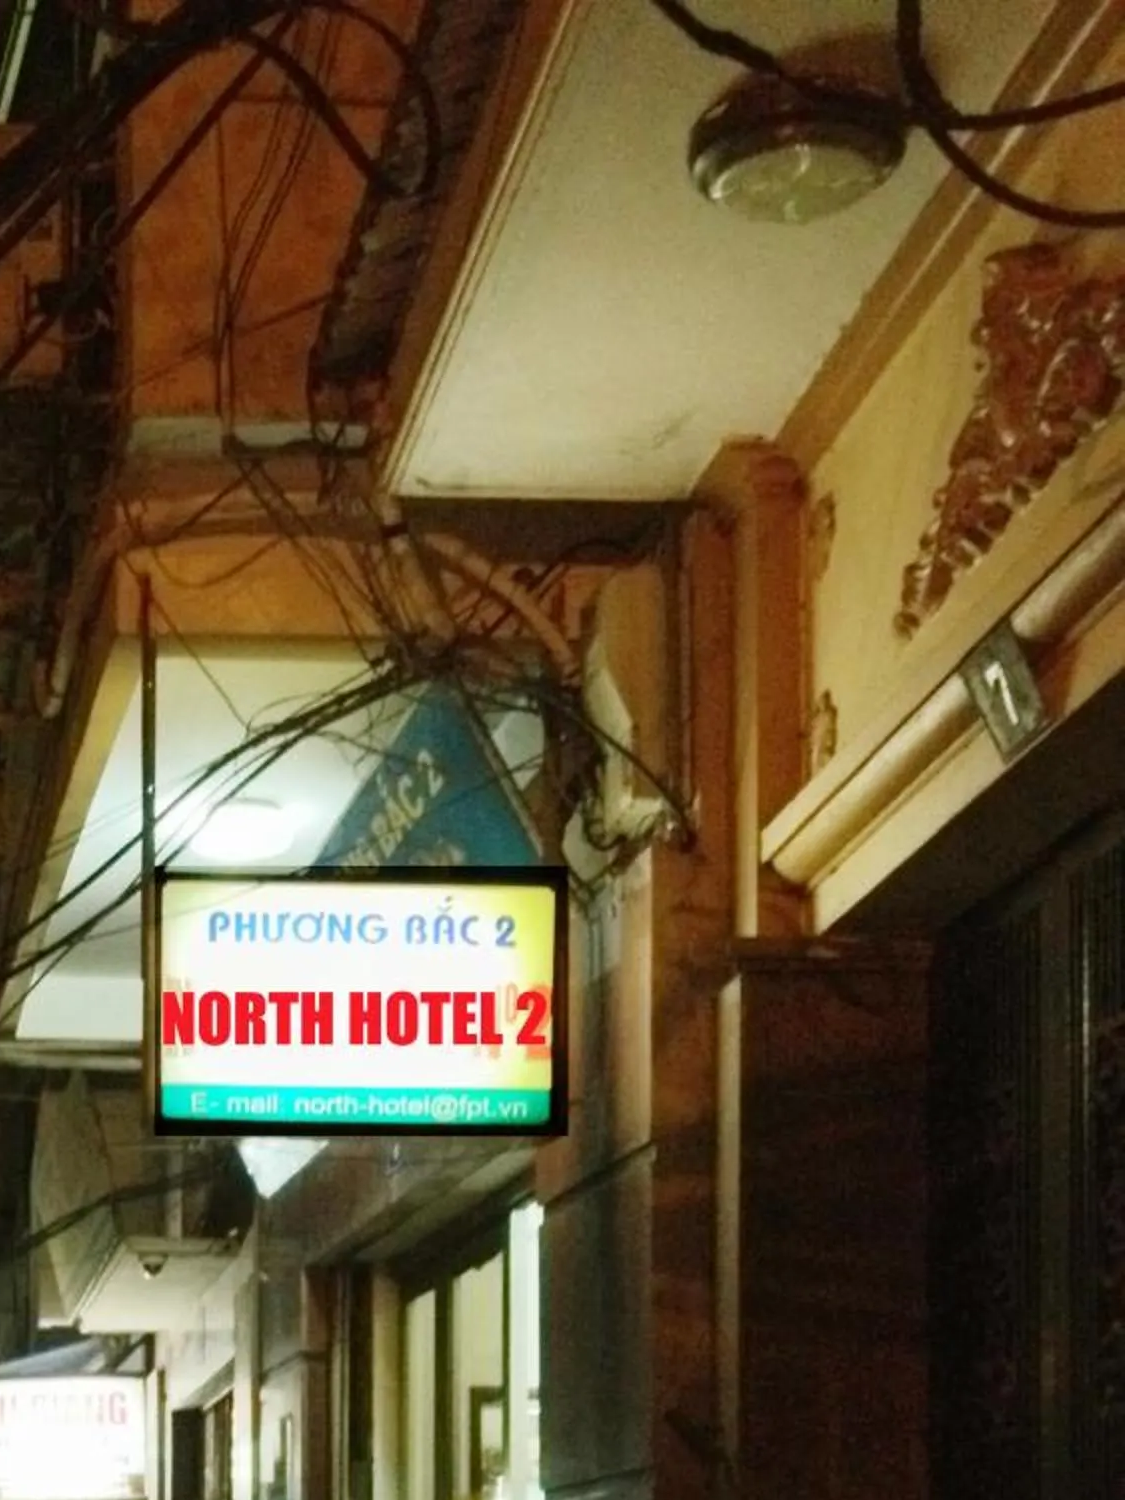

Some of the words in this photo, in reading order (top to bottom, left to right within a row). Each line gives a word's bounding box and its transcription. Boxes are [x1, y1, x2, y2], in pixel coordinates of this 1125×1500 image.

[208, 908, 388, 945] PHƯƠNG
[405, 895, 481, 947] BẮC
[494, 914, 518, 947] 2
[161, 990, 334, 1047] NORTH
[348, 990, 503, 1047] HOTEL
[516, 990, 547, 1046] 2
[294, 1090, 528, 1121] north-hotel@fpt.vn
